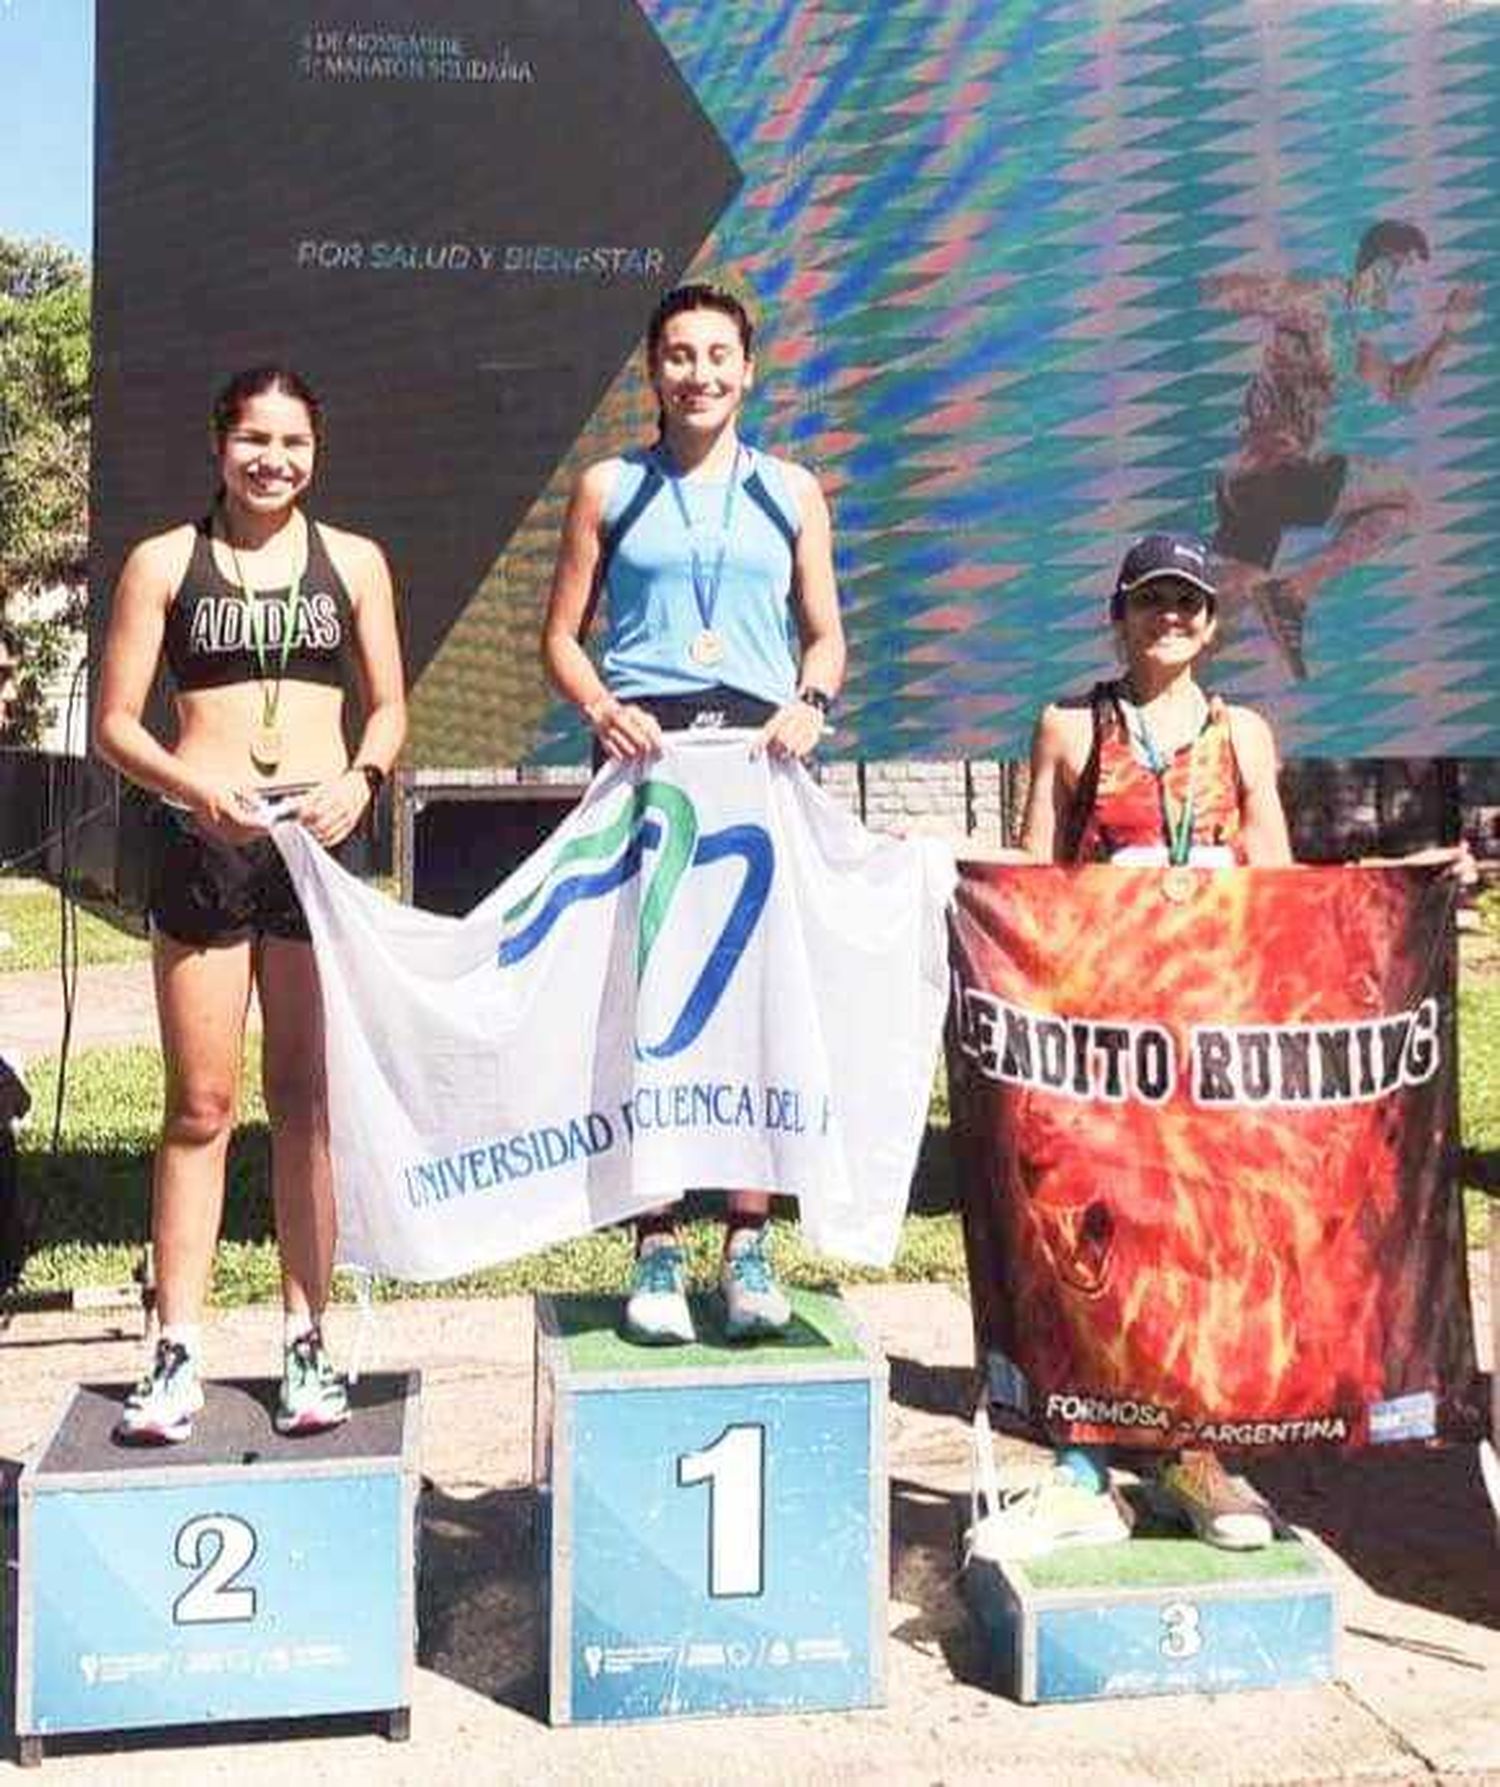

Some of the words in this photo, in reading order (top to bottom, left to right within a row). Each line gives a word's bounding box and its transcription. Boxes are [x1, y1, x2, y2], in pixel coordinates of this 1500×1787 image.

[299, 241, 362, 270] POR
[369, 243, 470, 272] SALUD
[504, 245, 665, 277] BIENESTAR
[191, 594, 342, 652] ADIDAS
[1192, 998, 1440, 1106] RUNNING
[404, 1111, 614, 1208] UNIVERSIDAD
[635, 1083, 755, 1131] CUENCA
[765, 1087, 806, 1134] DEL
[1046, 1394, 1170, 1430] FORMOSA
[1200, 1417, 1347, 1444] ARGENTINA
[677, 1422, 766, 1598] 1
[173, 1512, 257, 1626] 2
[1158, 1600, 1202, 1660] 3
